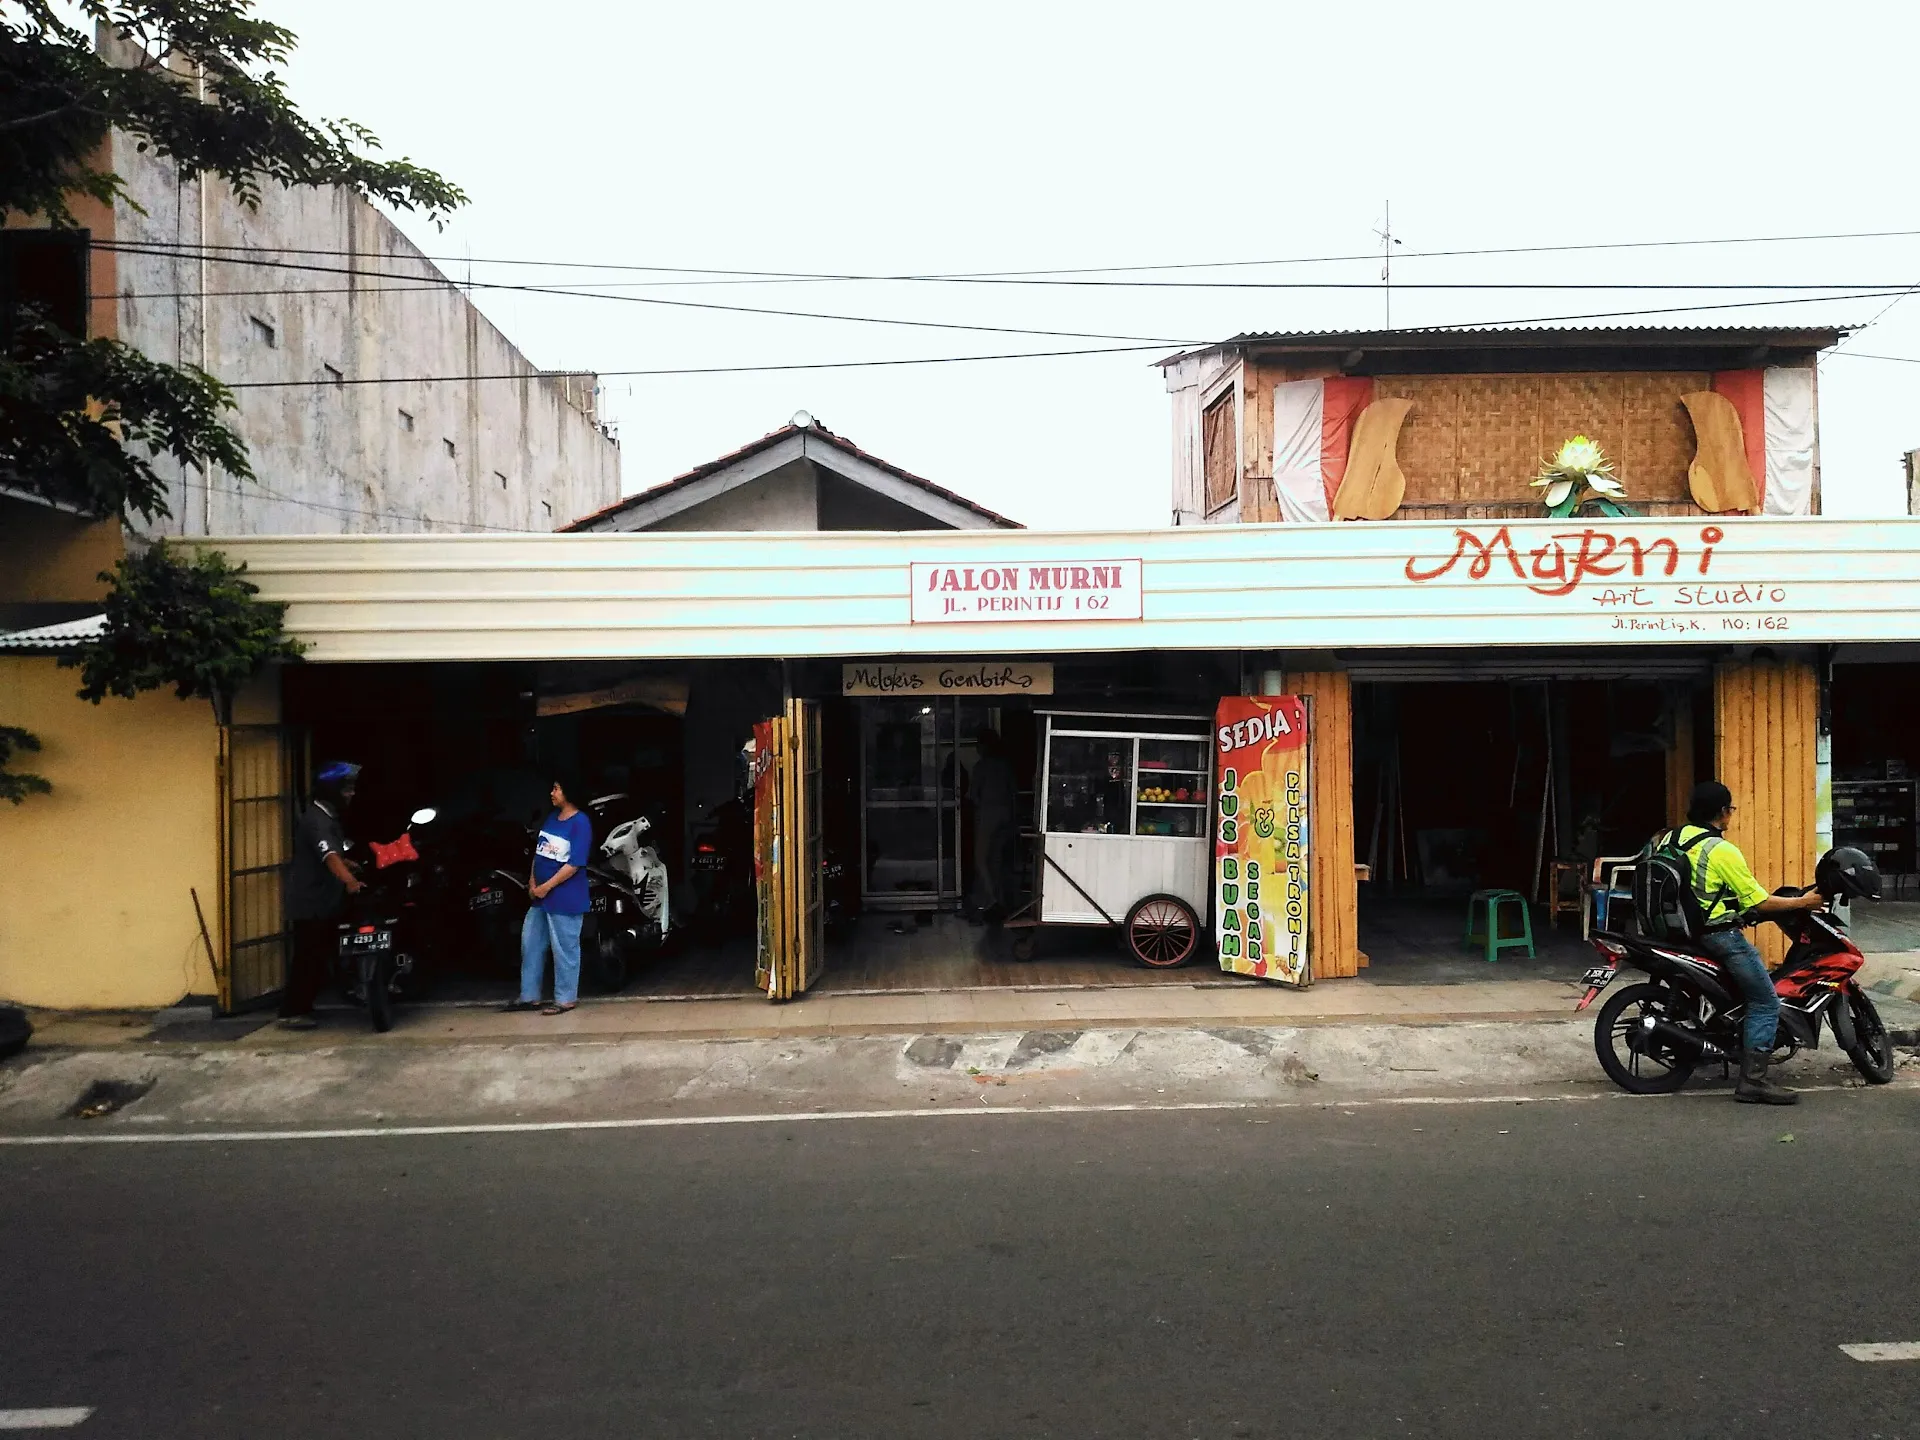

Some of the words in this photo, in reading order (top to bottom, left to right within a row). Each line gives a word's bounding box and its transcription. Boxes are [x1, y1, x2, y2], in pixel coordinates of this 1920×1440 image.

[928, 568, 1019, 592] SALON
[1029, 566, 1122, 590] MURNI
[943, 597, 967, 615] JL.
[977, 596, 1064, 612] PERINTIS
[1592, 586, 1653, 606] Art
[1221, 768, 1239, 842] JUS
[1286, 772, 1300, 859] PULSA
[1222, 857, 1241, 957] BUAH
[1246, 861, 1262, 960] SEGAR
